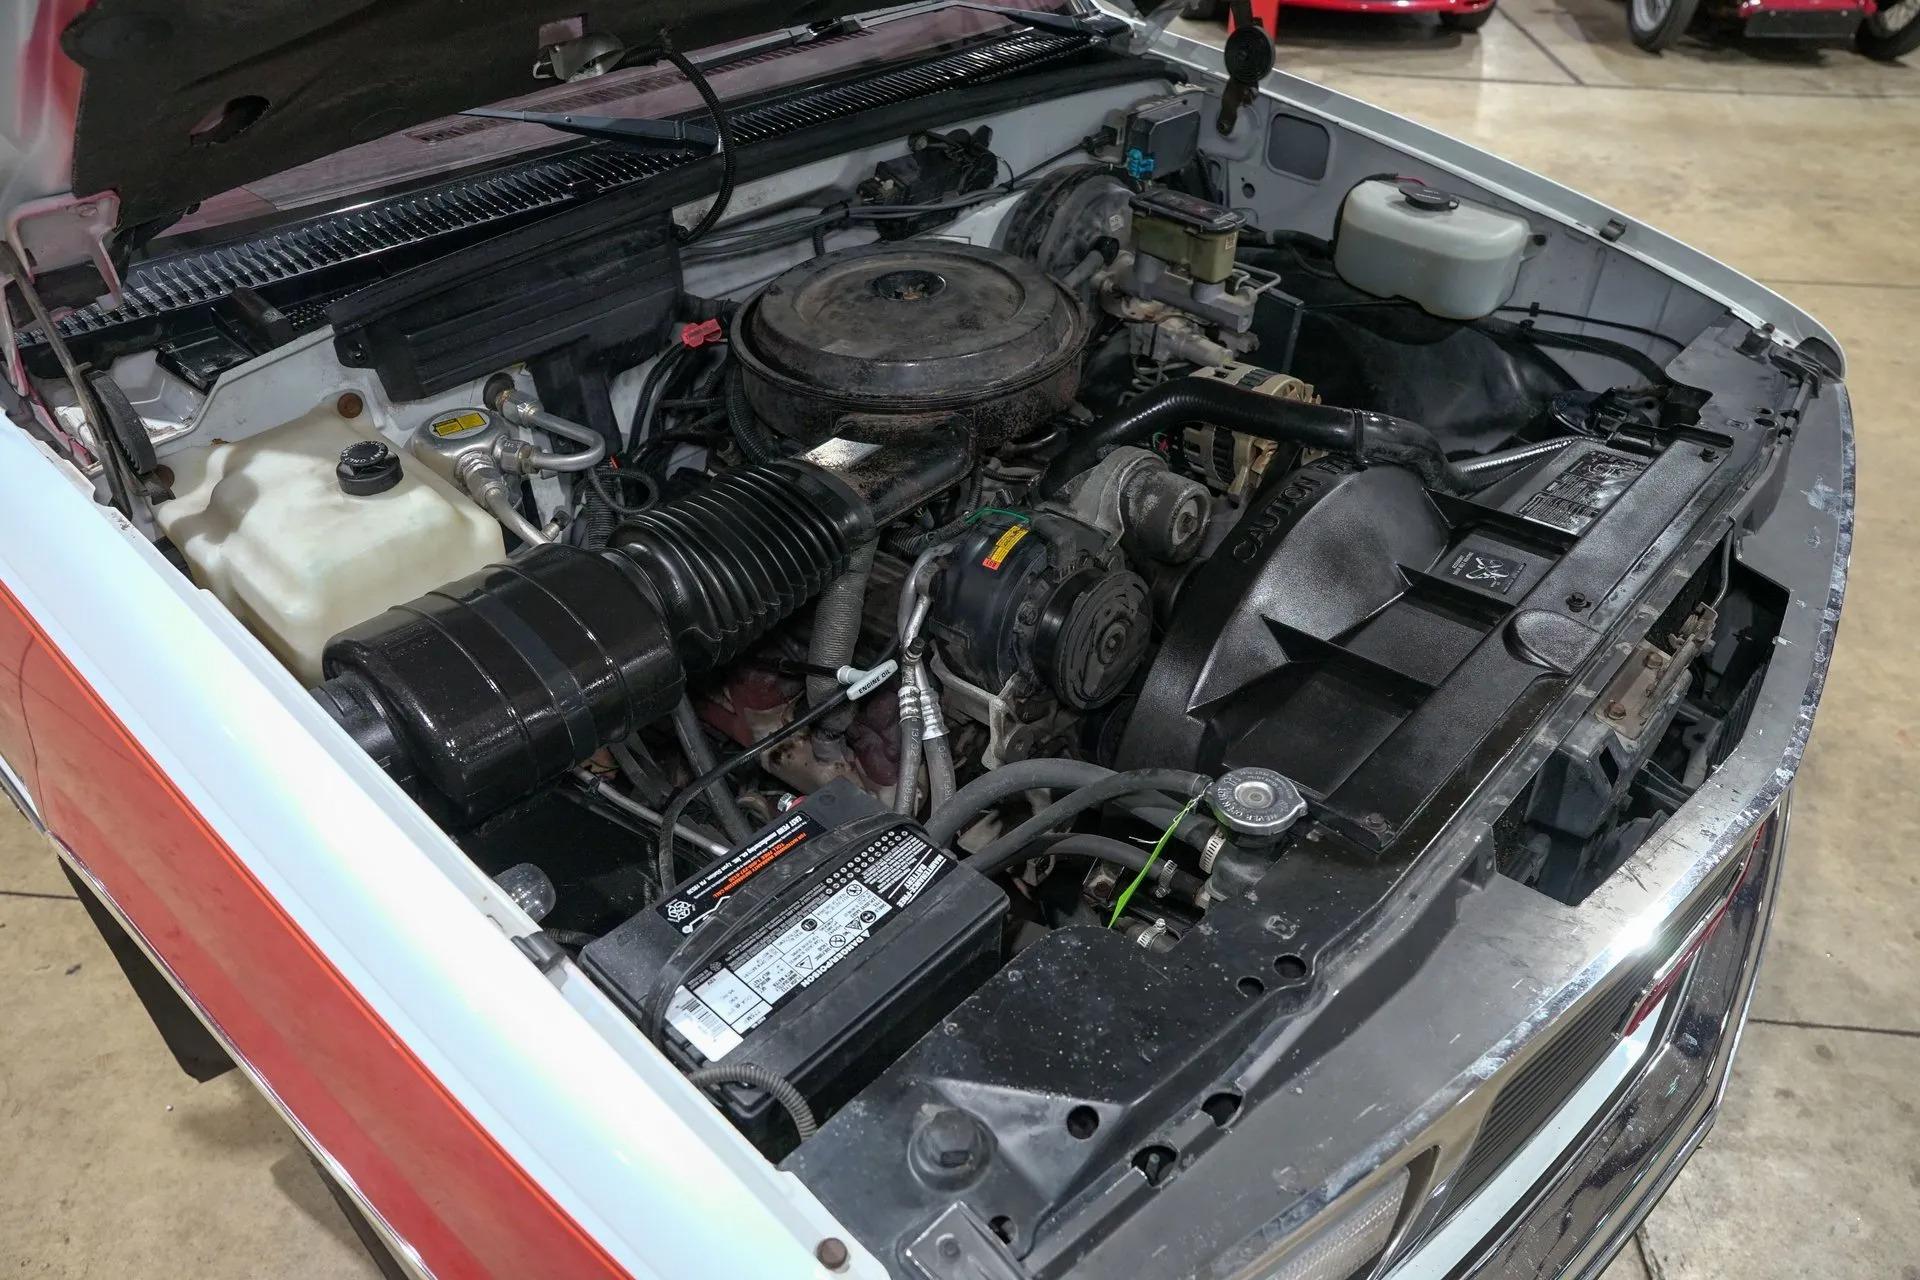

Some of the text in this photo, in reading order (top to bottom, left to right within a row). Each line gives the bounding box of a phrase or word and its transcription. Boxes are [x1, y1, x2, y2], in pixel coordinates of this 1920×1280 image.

[1233, 477, 1322, 561] CAUTION
[858, 669, 892, 695] ENGINE OIL
[787, 815, 803, 826] EAST
[1245, 813, 1277, 821] NEVER
[774, 823, 791, 835] PENN
[771, 842, 784, 852] TOLL
[719, 861, 733, 871] Lyon
[750, 854, 775, 872] WARRANTY
[722, 869, 753, 891] INFORMATION
[896, 854, 944, 907] MAINTENANCE-FREE
[903, 863, 926, 888] BATTERY
[798, 935, 865, 989] DANGER/POISON
